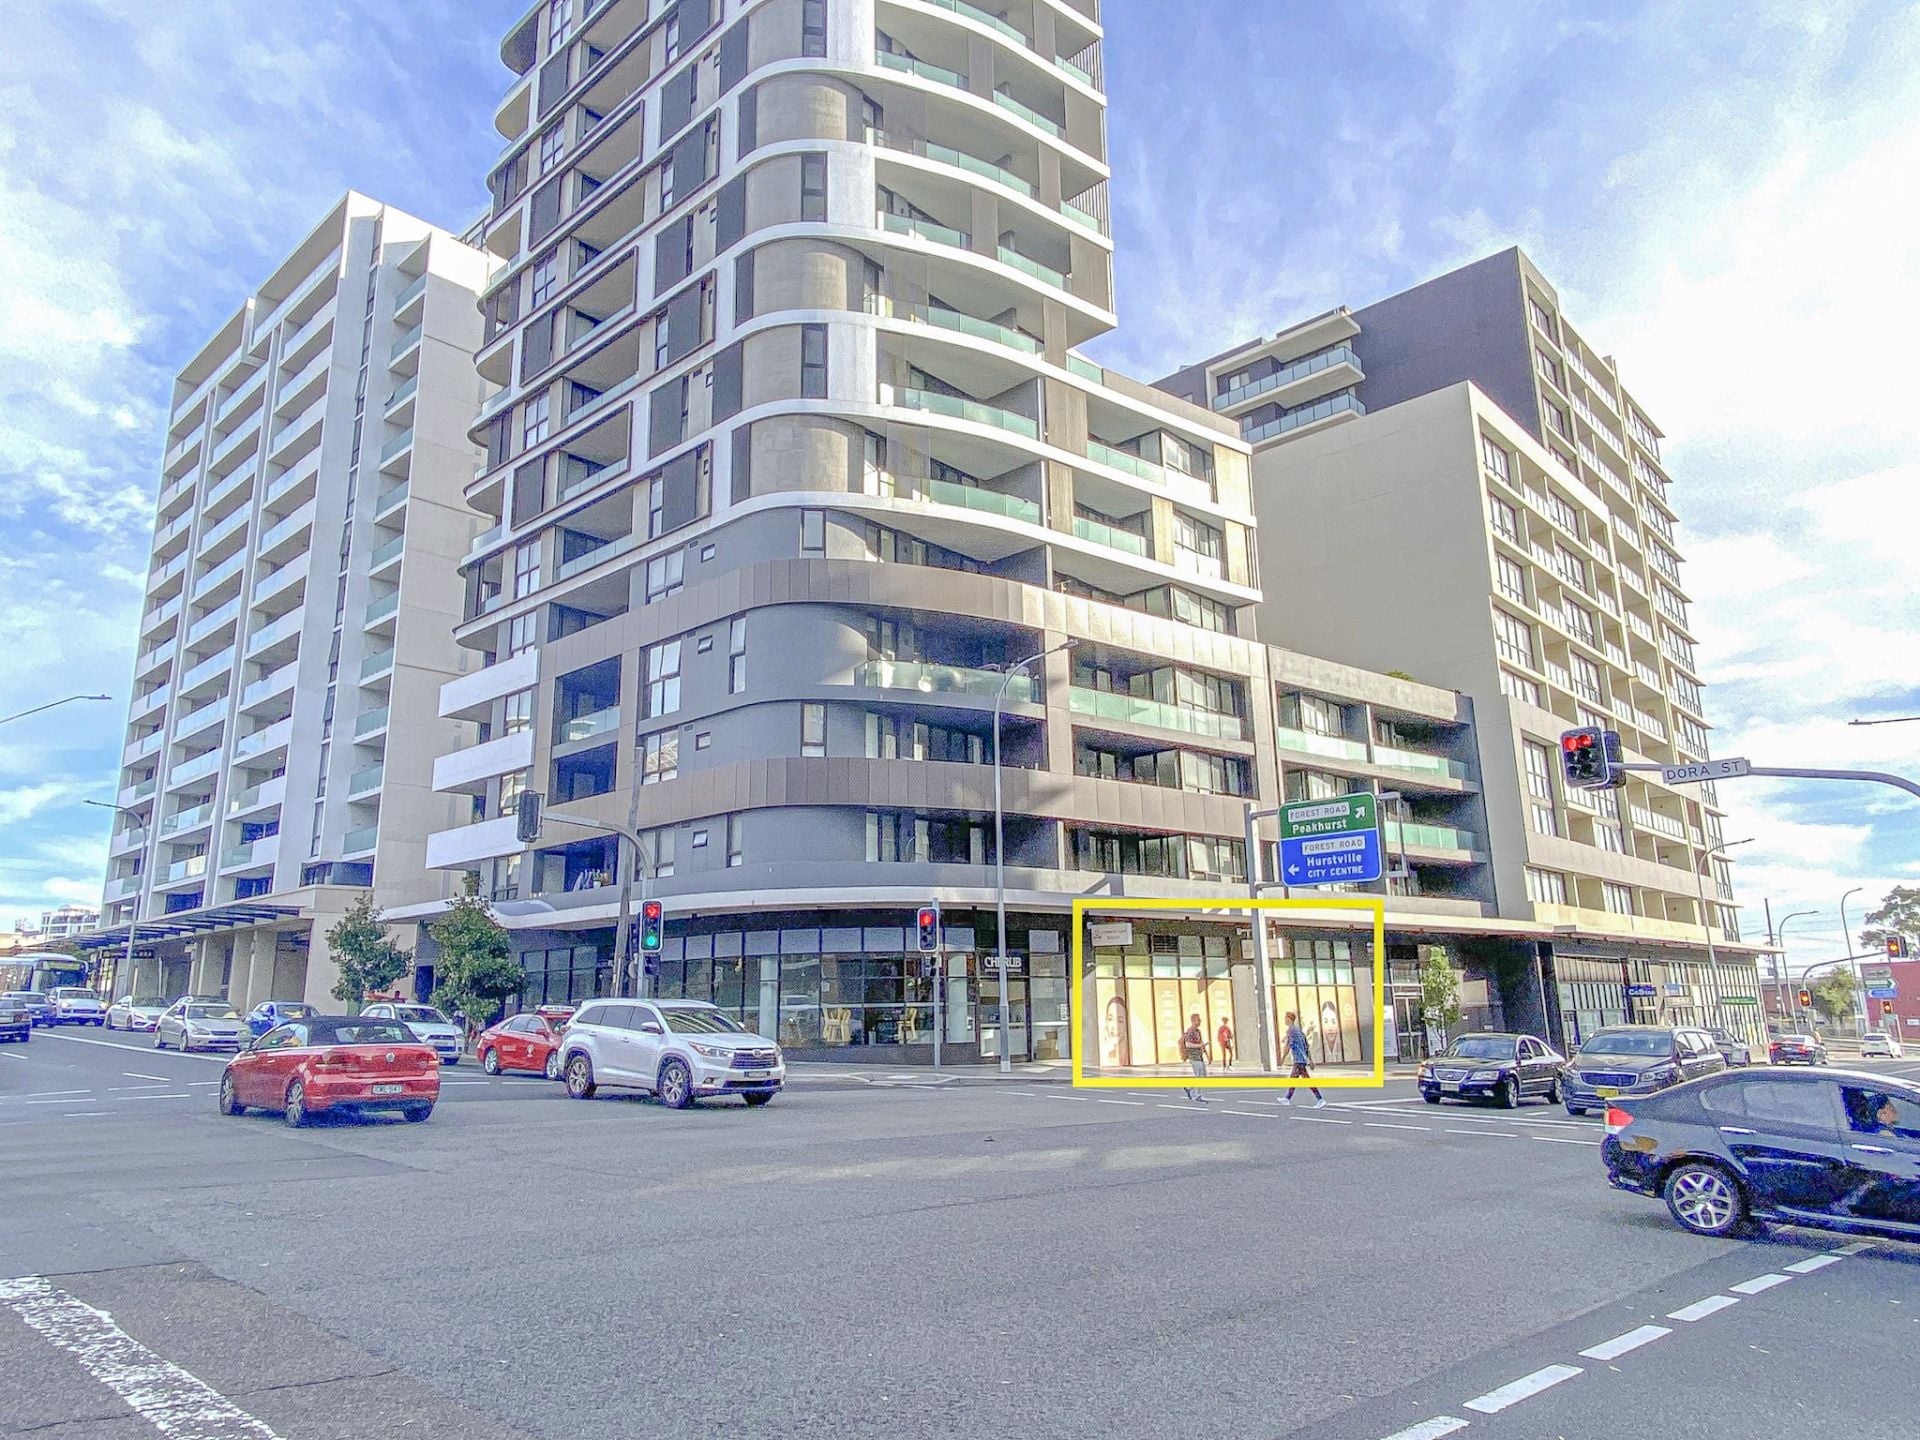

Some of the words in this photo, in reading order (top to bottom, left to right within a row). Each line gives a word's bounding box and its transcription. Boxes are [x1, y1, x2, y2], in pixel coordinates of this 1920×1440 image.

[1667, 766, 1710, 780] DORA
[1721, 761, 1740, 773] ST
[1290, 808, 1320, 820] FOREST
[1324, 805, 1348, 817] ROAD
[1292, 819, 1347, 834] Peakhurst
[1304, 841, 1335, 852] FOREST
[1340, 839, 1363, 848] ROAD
[1307, 853, 1362, 867] Hurstville
[1307, 868, 1327, 878] CITY
[1330, 865, 1364, 876] CENTRE
[984, 956, 1022, 968] CHRUB
